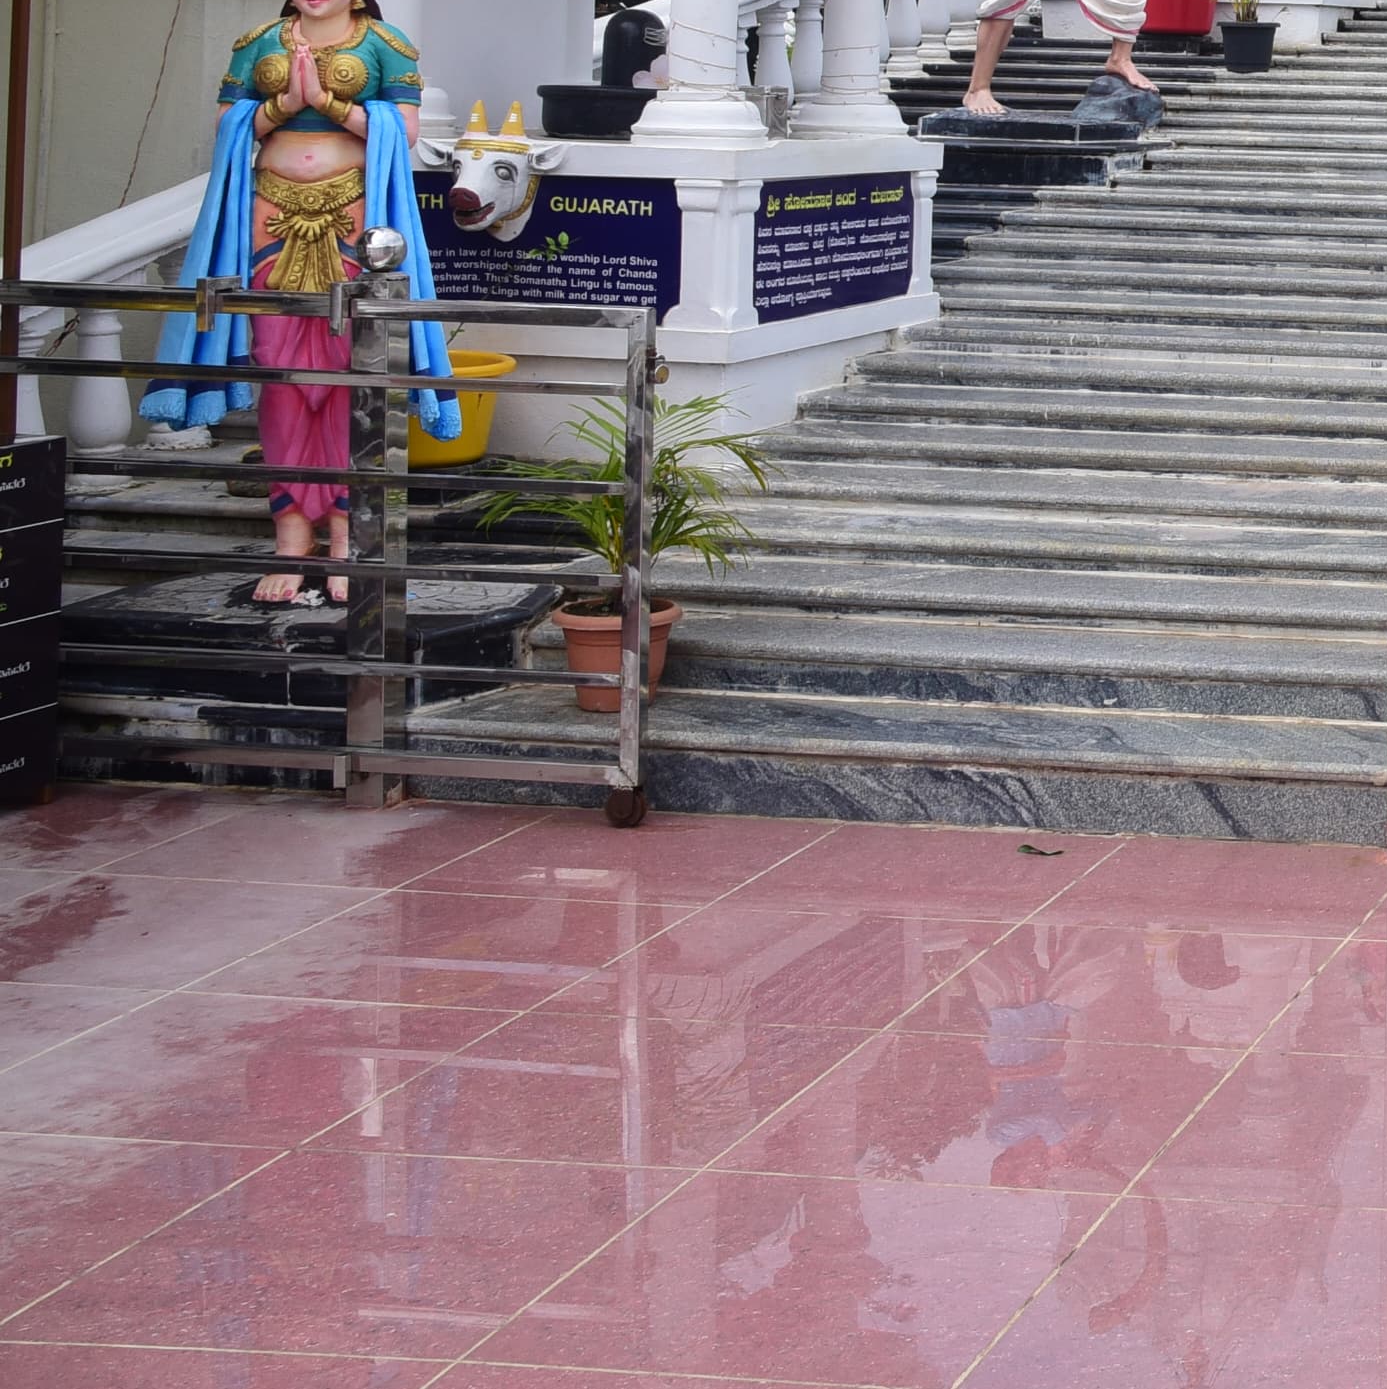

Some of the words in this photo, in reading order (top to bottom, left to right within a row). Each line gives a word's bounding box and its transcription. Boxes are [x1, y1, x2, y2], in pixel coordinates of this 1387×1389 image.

[550, 196, 653, 216] GUJARATH
[446, 248, 455, 256] in
[459, 248, 477, 256] law
[480, 248, 490, 257] of
[560, 254, 600, 265] worship
[603, 255, 626, 265] Lord
[629, 256, 658, 266] Shiva
[434, 272, 480, 281] eshwara.
[513, 274, 567, 286] Somanatha
[604, 280, 612, 289] is
[616, 280, 657, 291] famous.
[547, 265, 563, 273] the
[568, 267, 596, 276] name
[602, 268, 612, 276] of
[619, 268, 657, 279] Chanda
[436, 284, 468, 293] ointed
[472, 285, 488, 293] the
[491, 285, 519, 298] Linga
[522, 288, 542, 298] with
[545, 289, 565, 299] milk
[568, 292, 587, 300] and
[590, 293, 620, 303] sugar
[641, 296, 657, 305] get
